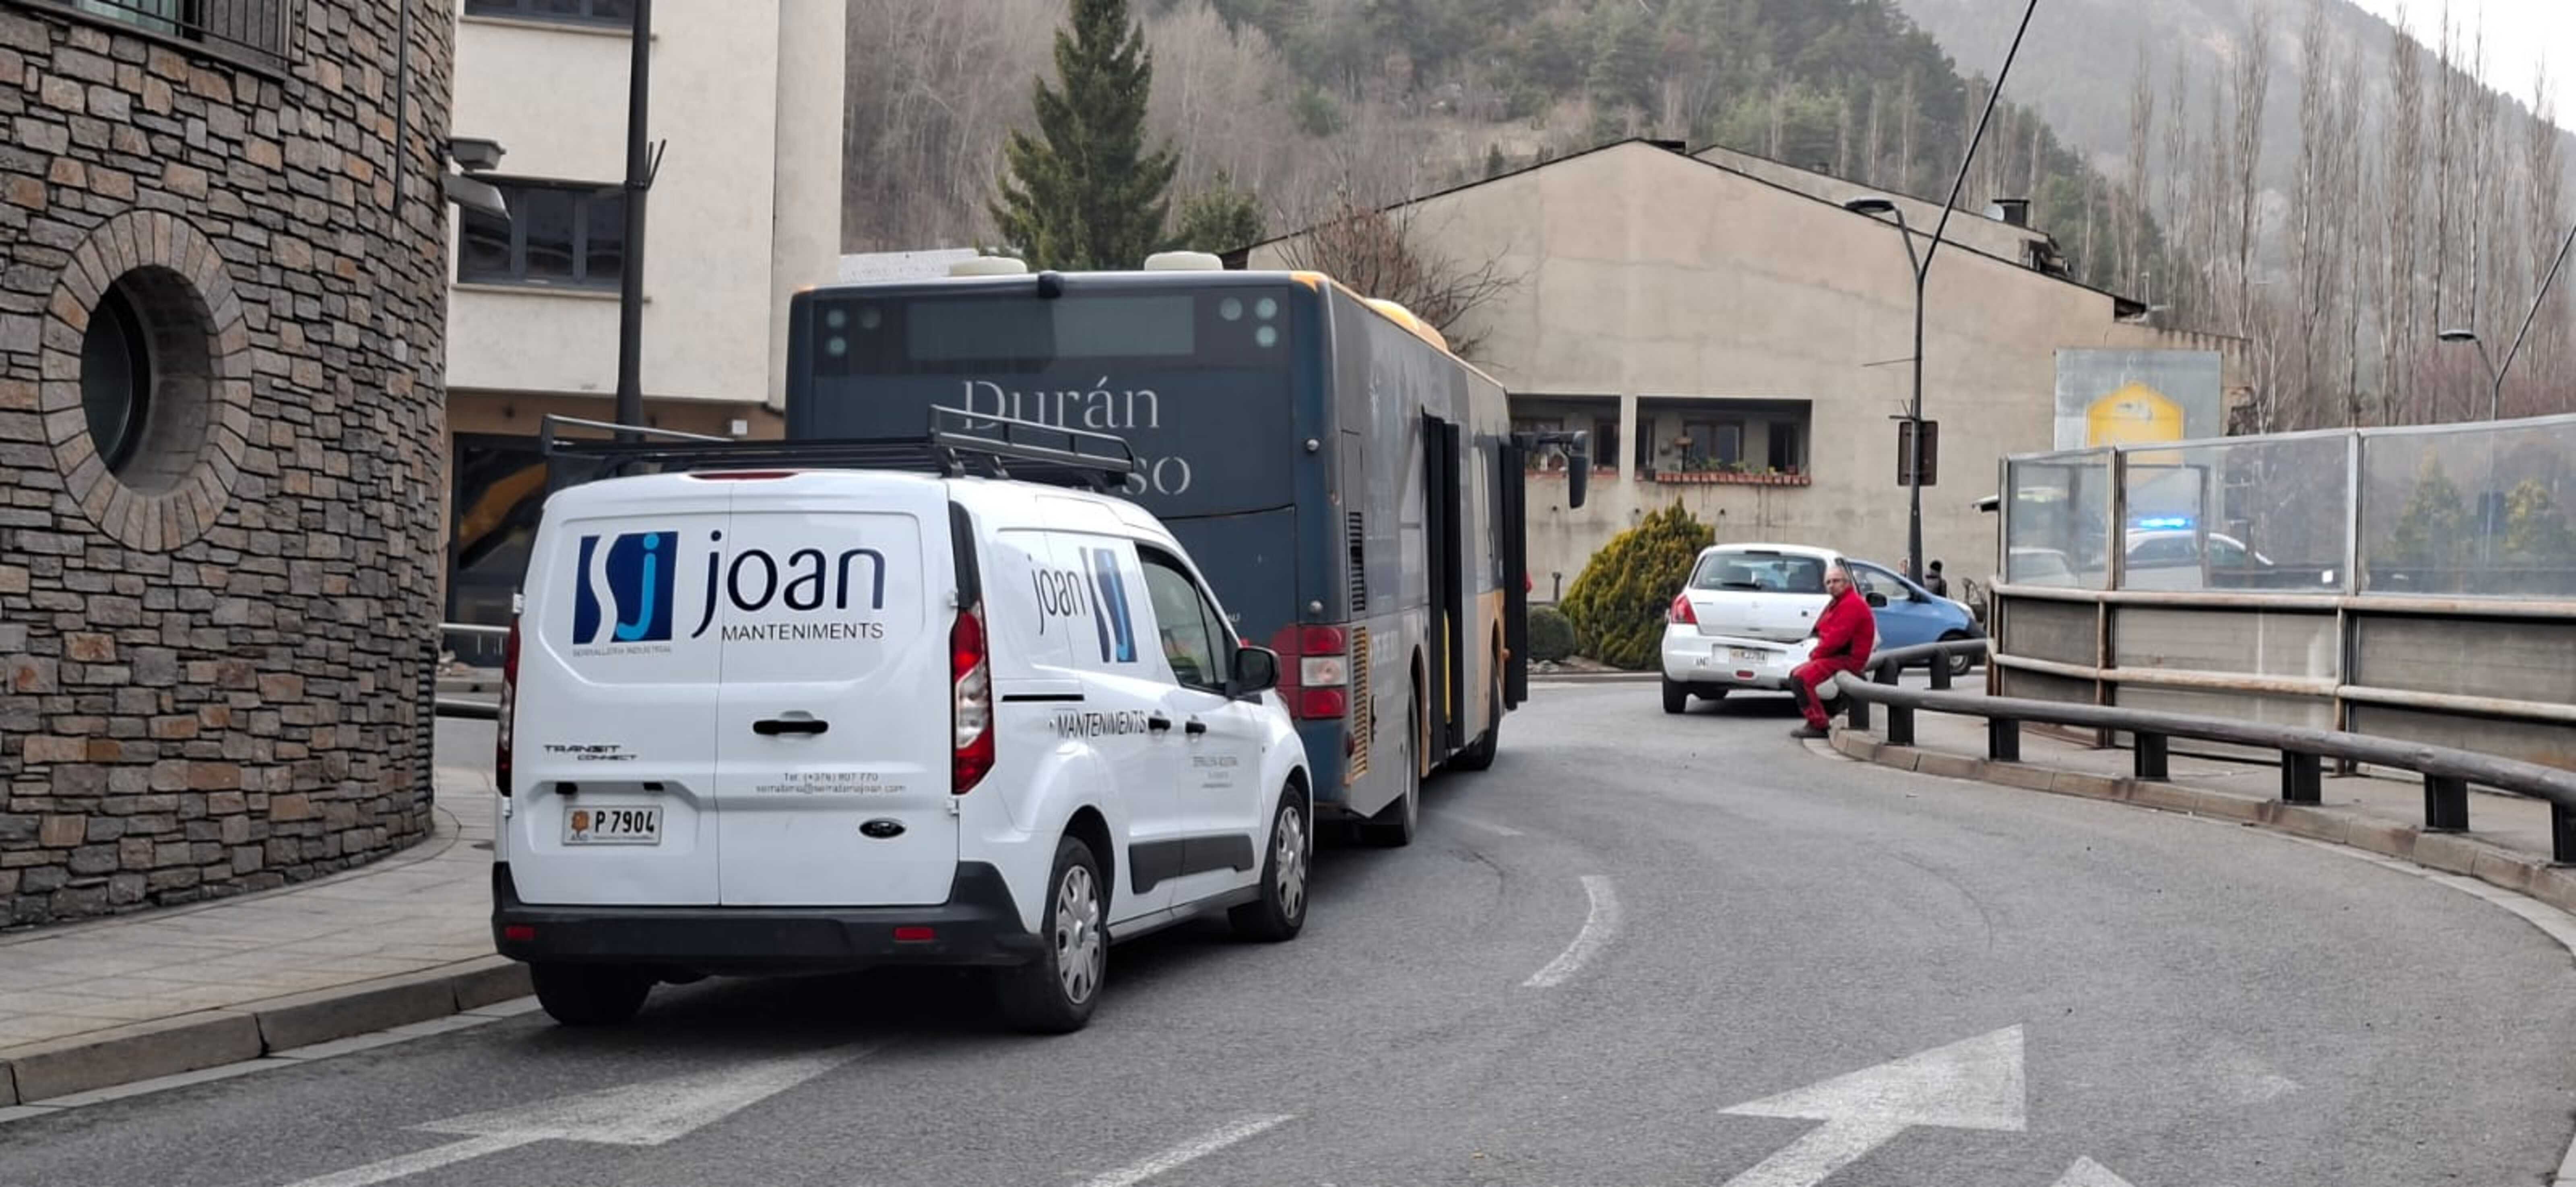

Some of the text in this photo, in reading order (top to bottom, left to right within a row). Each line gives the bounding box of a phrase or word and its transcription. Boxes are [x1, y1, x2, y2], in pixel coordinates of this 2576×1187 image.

[962, 375, 1160, 429] Durán
[691, 530, 886, 639] joan
[1027, 553, 1086, 636] joan
[722, 622, 883, 641] MANTENIMENTS
[1058, 709, 1147, 738] MANTENIMENTS
[595, 811, 654, 833] P 7904
